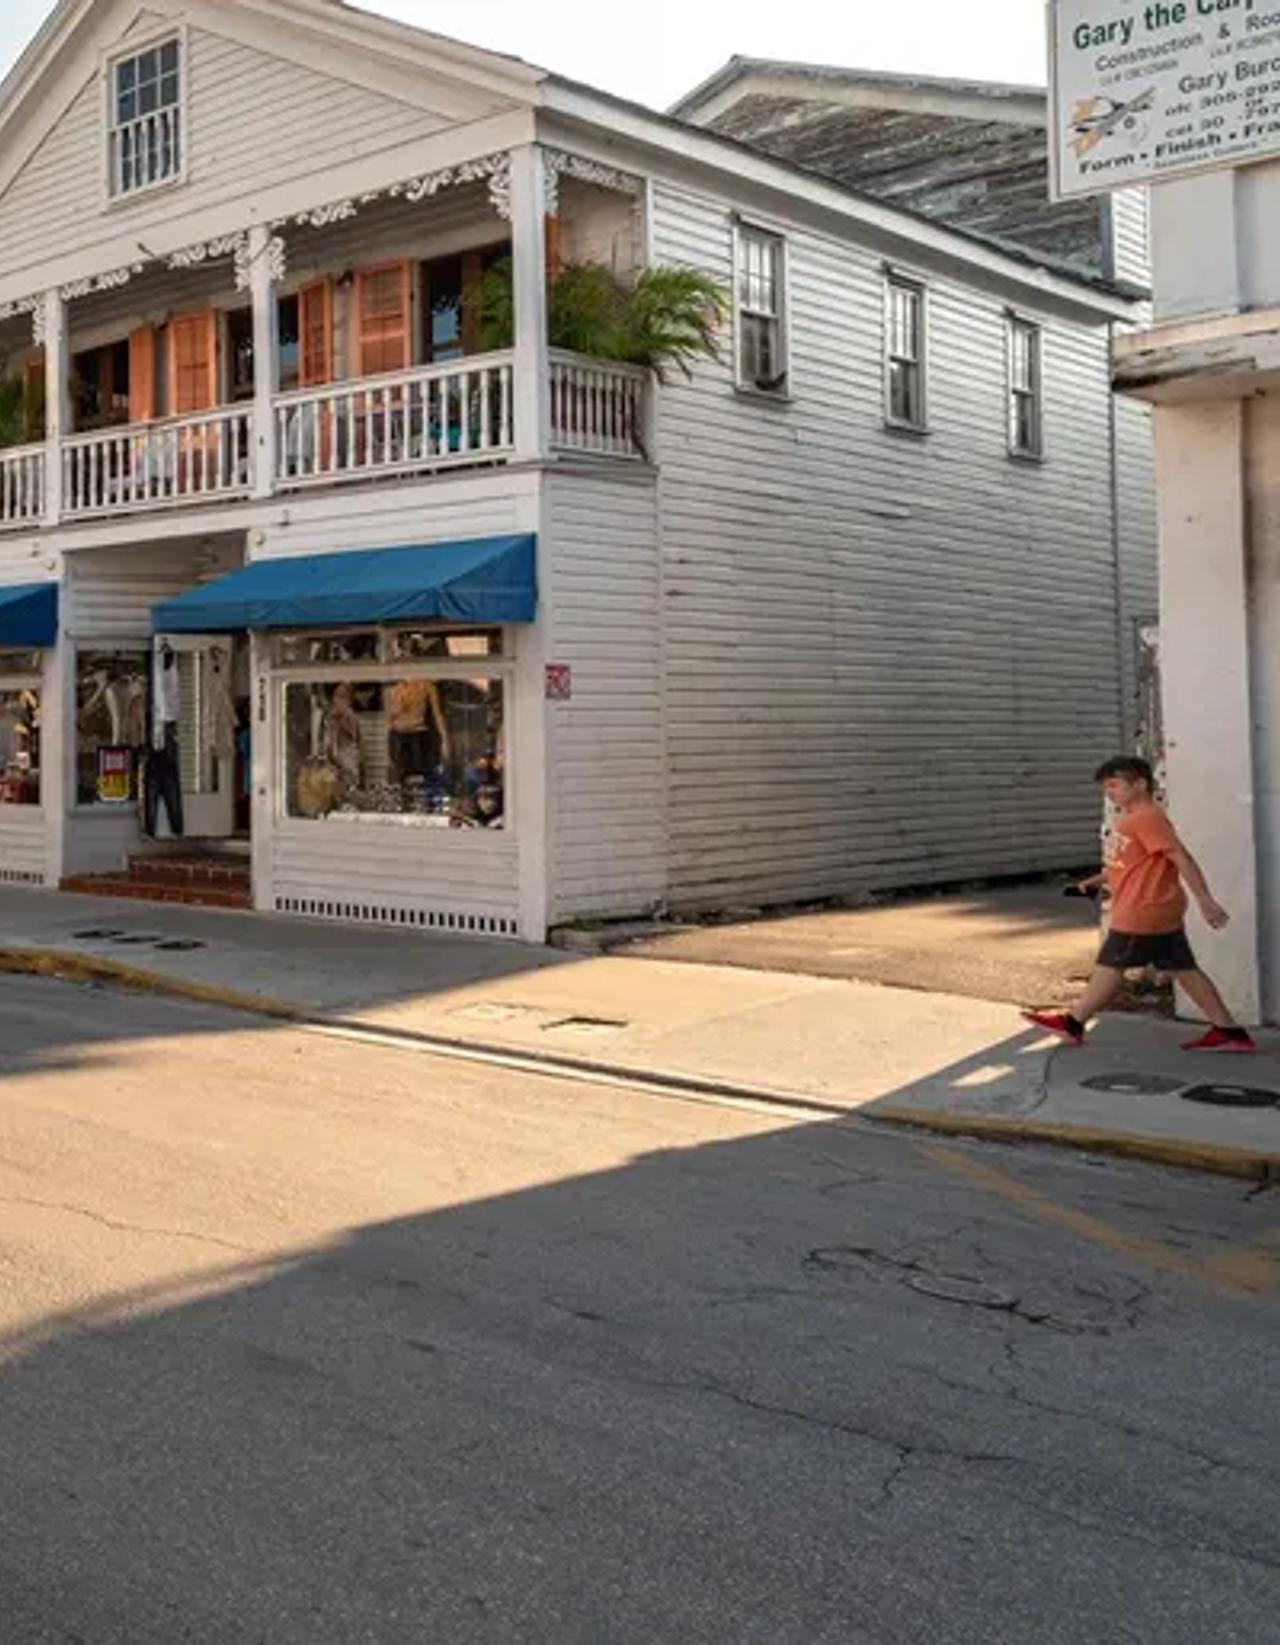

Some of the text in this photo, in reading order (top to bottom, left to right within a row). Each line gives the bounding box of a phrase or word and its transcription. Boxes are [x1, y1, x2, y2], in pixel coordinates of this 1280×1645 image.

[1073, 16, 1134, 50] Gary
[1143, 2, 1186, 31] the
[1095, 33, 1203, 71] Construction
[1218, 22, 1231, 39] &
[1178, 71, 1228, 94] Gary
[1078, 153, 1135, 174] Form
[1154, 132, 1221, 158] Finish
